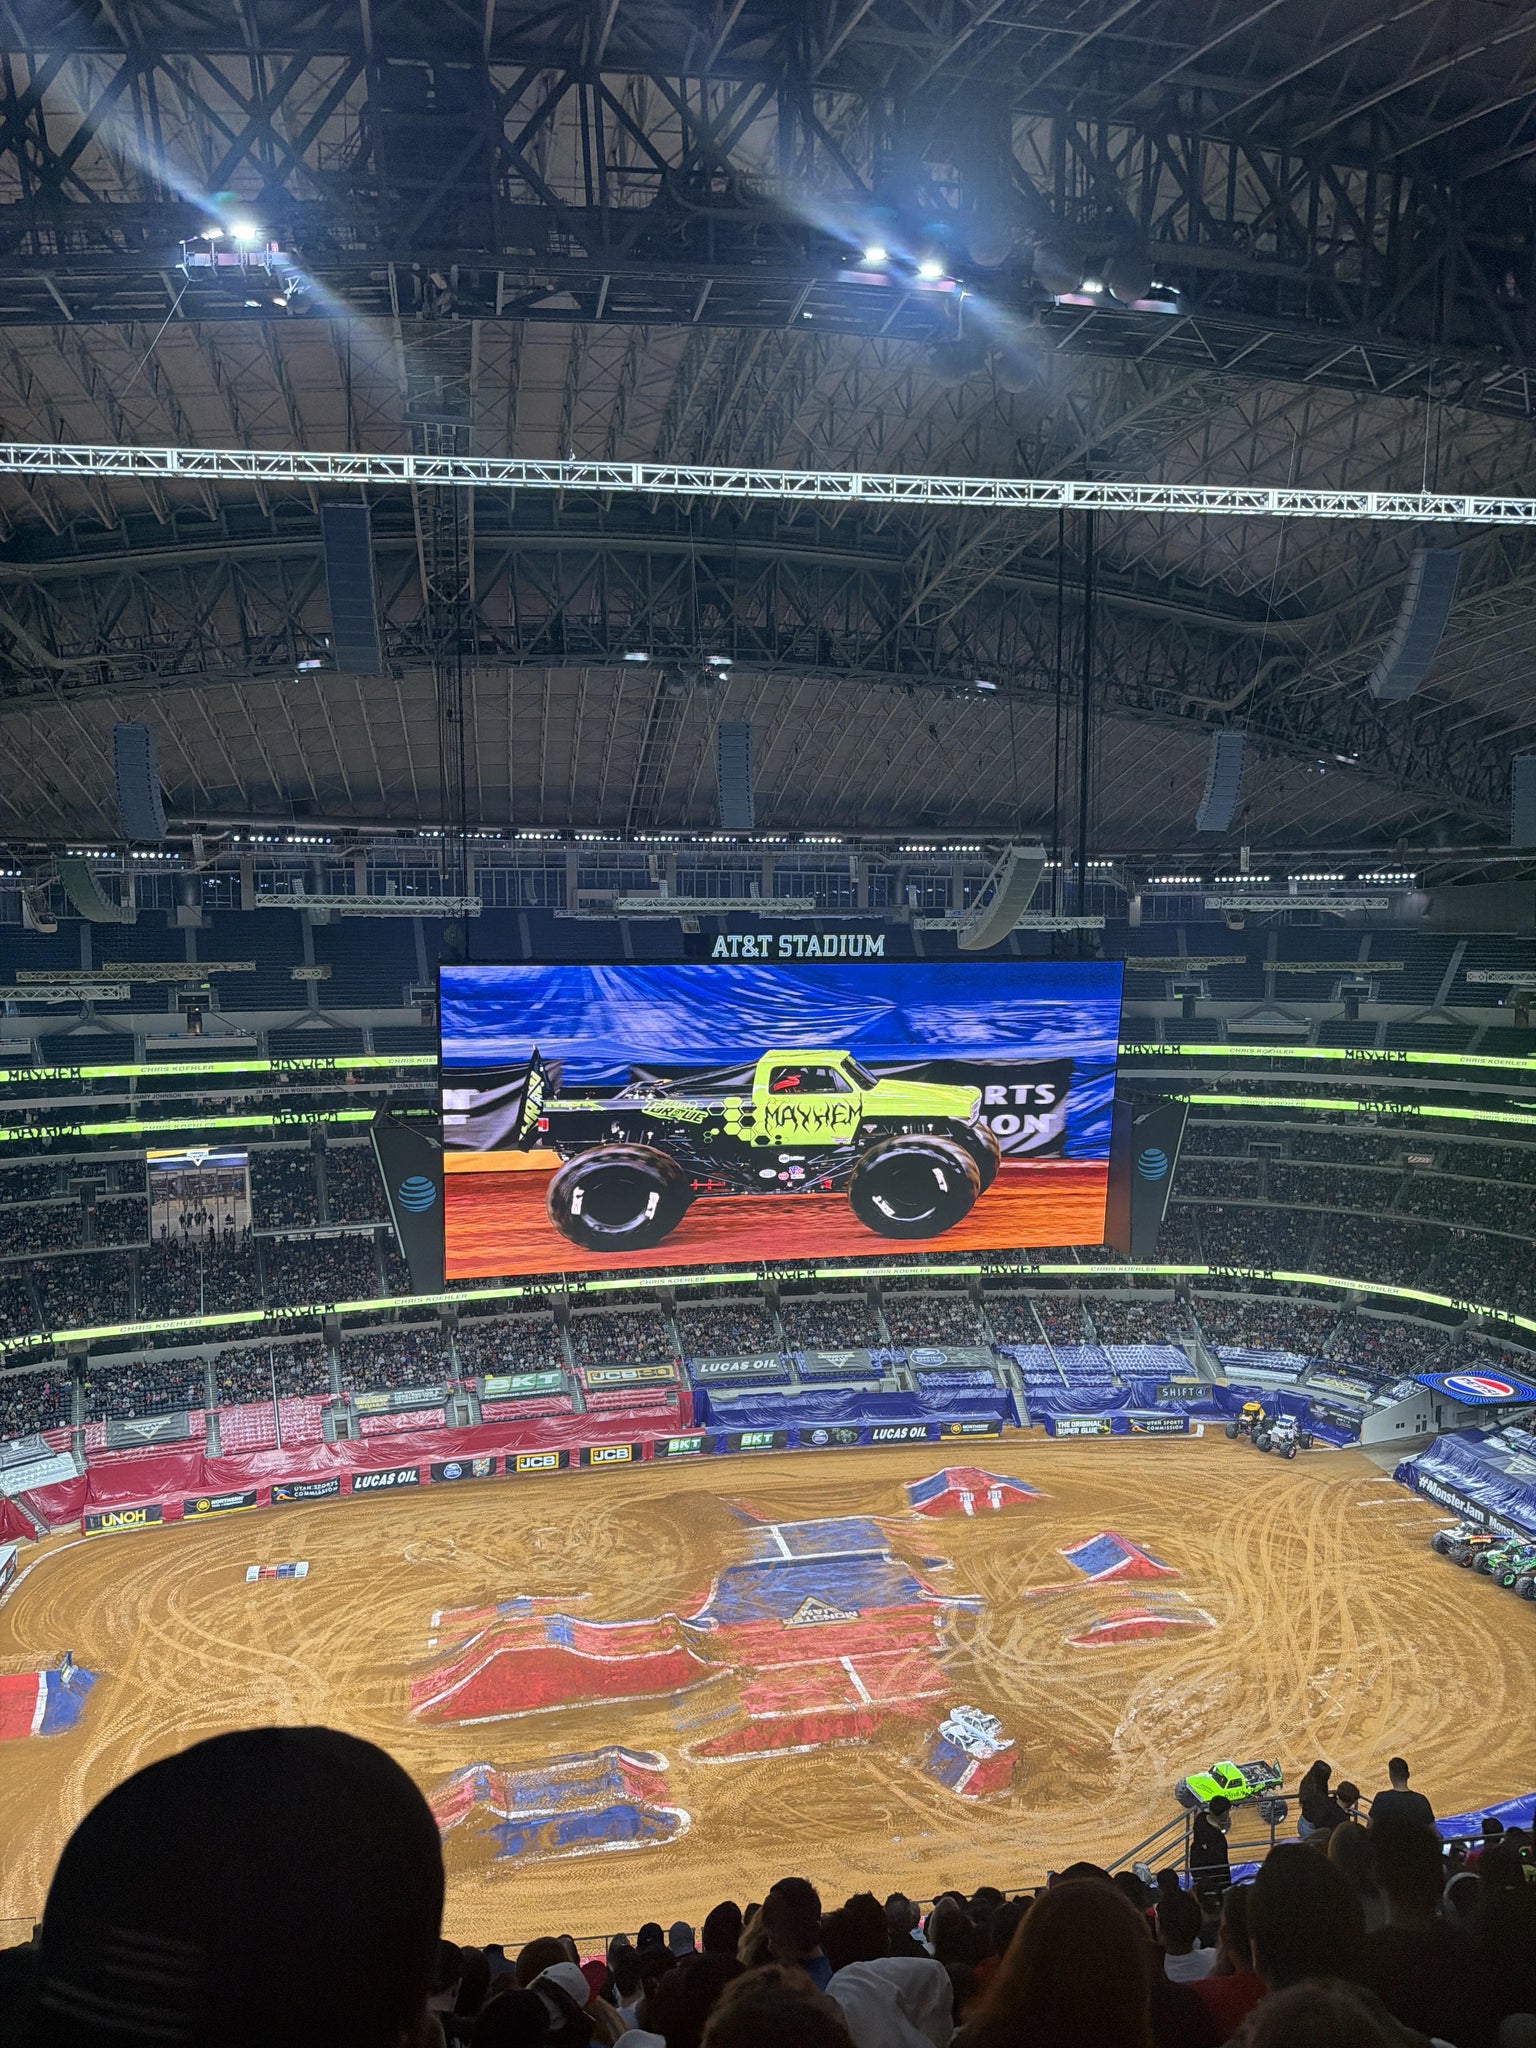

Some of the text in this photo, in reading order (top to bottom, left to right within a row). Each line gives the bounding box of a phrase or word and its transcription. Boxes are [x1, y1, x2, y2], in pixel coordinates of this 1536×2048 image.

[712, 935, 885, 957] AT&T STADIUM
[1124, 1045, 1181, 1054] MAYHEM
[1345, 1050, 1407, 1062] MAYHEM
[171, 1064, 215, 1072] KOEHLER
[270, 1058, 335, 1070] MAYHEM
[1488, 1058, 1527, 1067] KOEHLER
[764, 1093, 862, 1137] MAYHEM
[756, 1270, 816, 1280] MAYHEM
[980, 1264, 1040, 1274] MAYHEM
[1209, 1266, 1273, 1279] MAYHEM
[522, 1283, 587, 1296] MAYHEM
[1328, 1279, 1400, 1294] CHRIS KOEHLER
[394, 1293, 468, 1305] CHRIS KOEHLER
[264, 1304, 335, 1319] MAYHEM
[120, 1319, 202, 1333] CHRIS KOEHLER
[700, 1358, 779, 1373] LUCAS OIL
[488, 1373, 559, 1390] BKT
[591, 1369, 638, 1381] JCB
[1071, 1420, 1102, 1428] ORIGINAL
[740, 1433, 773, 1445] BKT
[872, 1426, 927, 1440] LUCAS OIL
[668, 1438, 701, 1451] BKT
[594, 1448, 629, 1461] JCB
[520, 1455, 556, 1469] JCB
[313, 1480, 338, 1489] SPORTS
[354, 1470, 419, 1489] LUCAS OIL
[294, 1486, 338, 1498] COMMISSION
[1418, 1475, 1484, 1523] #MonsterJam
[101, 1509, 147, 1527] UNOH
